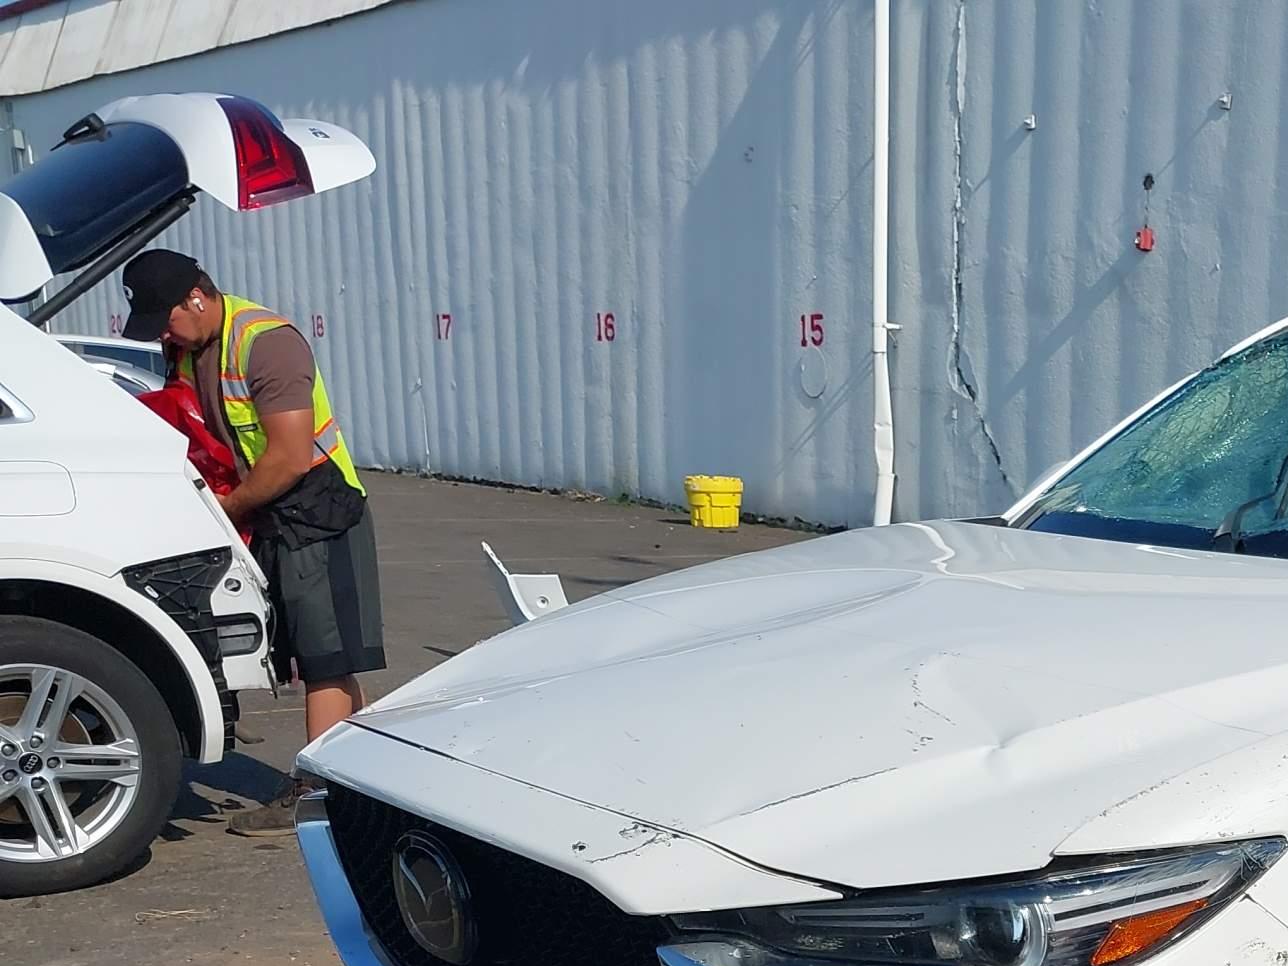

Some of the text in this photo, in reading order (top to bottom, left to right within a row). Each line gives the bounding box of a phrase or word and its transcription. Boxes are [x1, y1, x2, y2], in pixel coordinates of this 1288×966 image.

[311, 314, 325, 337] 18
[435, 313, 452, 340] 17
[596, 312, 616, 342] 16
[800, 313, 825, 347] 15
